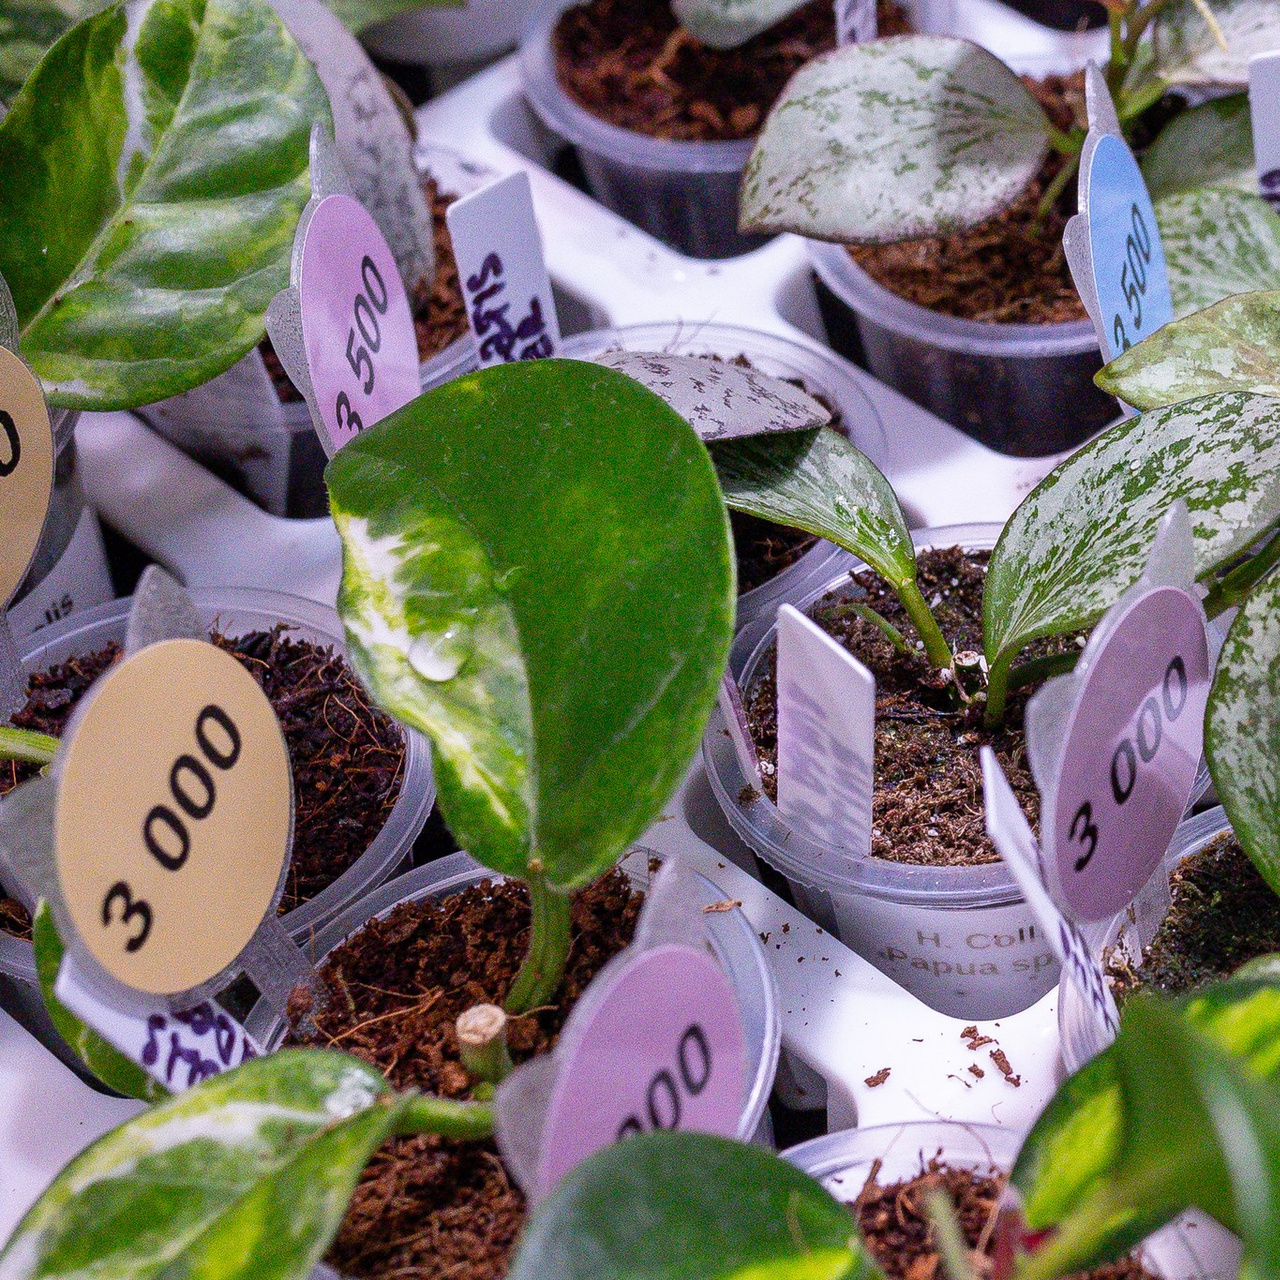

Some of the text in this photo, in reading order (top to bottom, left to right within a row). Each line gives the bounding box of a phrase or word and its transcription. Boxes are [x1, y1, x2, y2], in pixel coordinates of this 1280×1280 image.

[335, 254, 389, 435] 3 500
[1120, 203, 1151, 331] 500
[101, 704, 242, 954] 3 000
[1068, 800, 1099, 873] 3
[1110, 655, 1188, 805] 000
